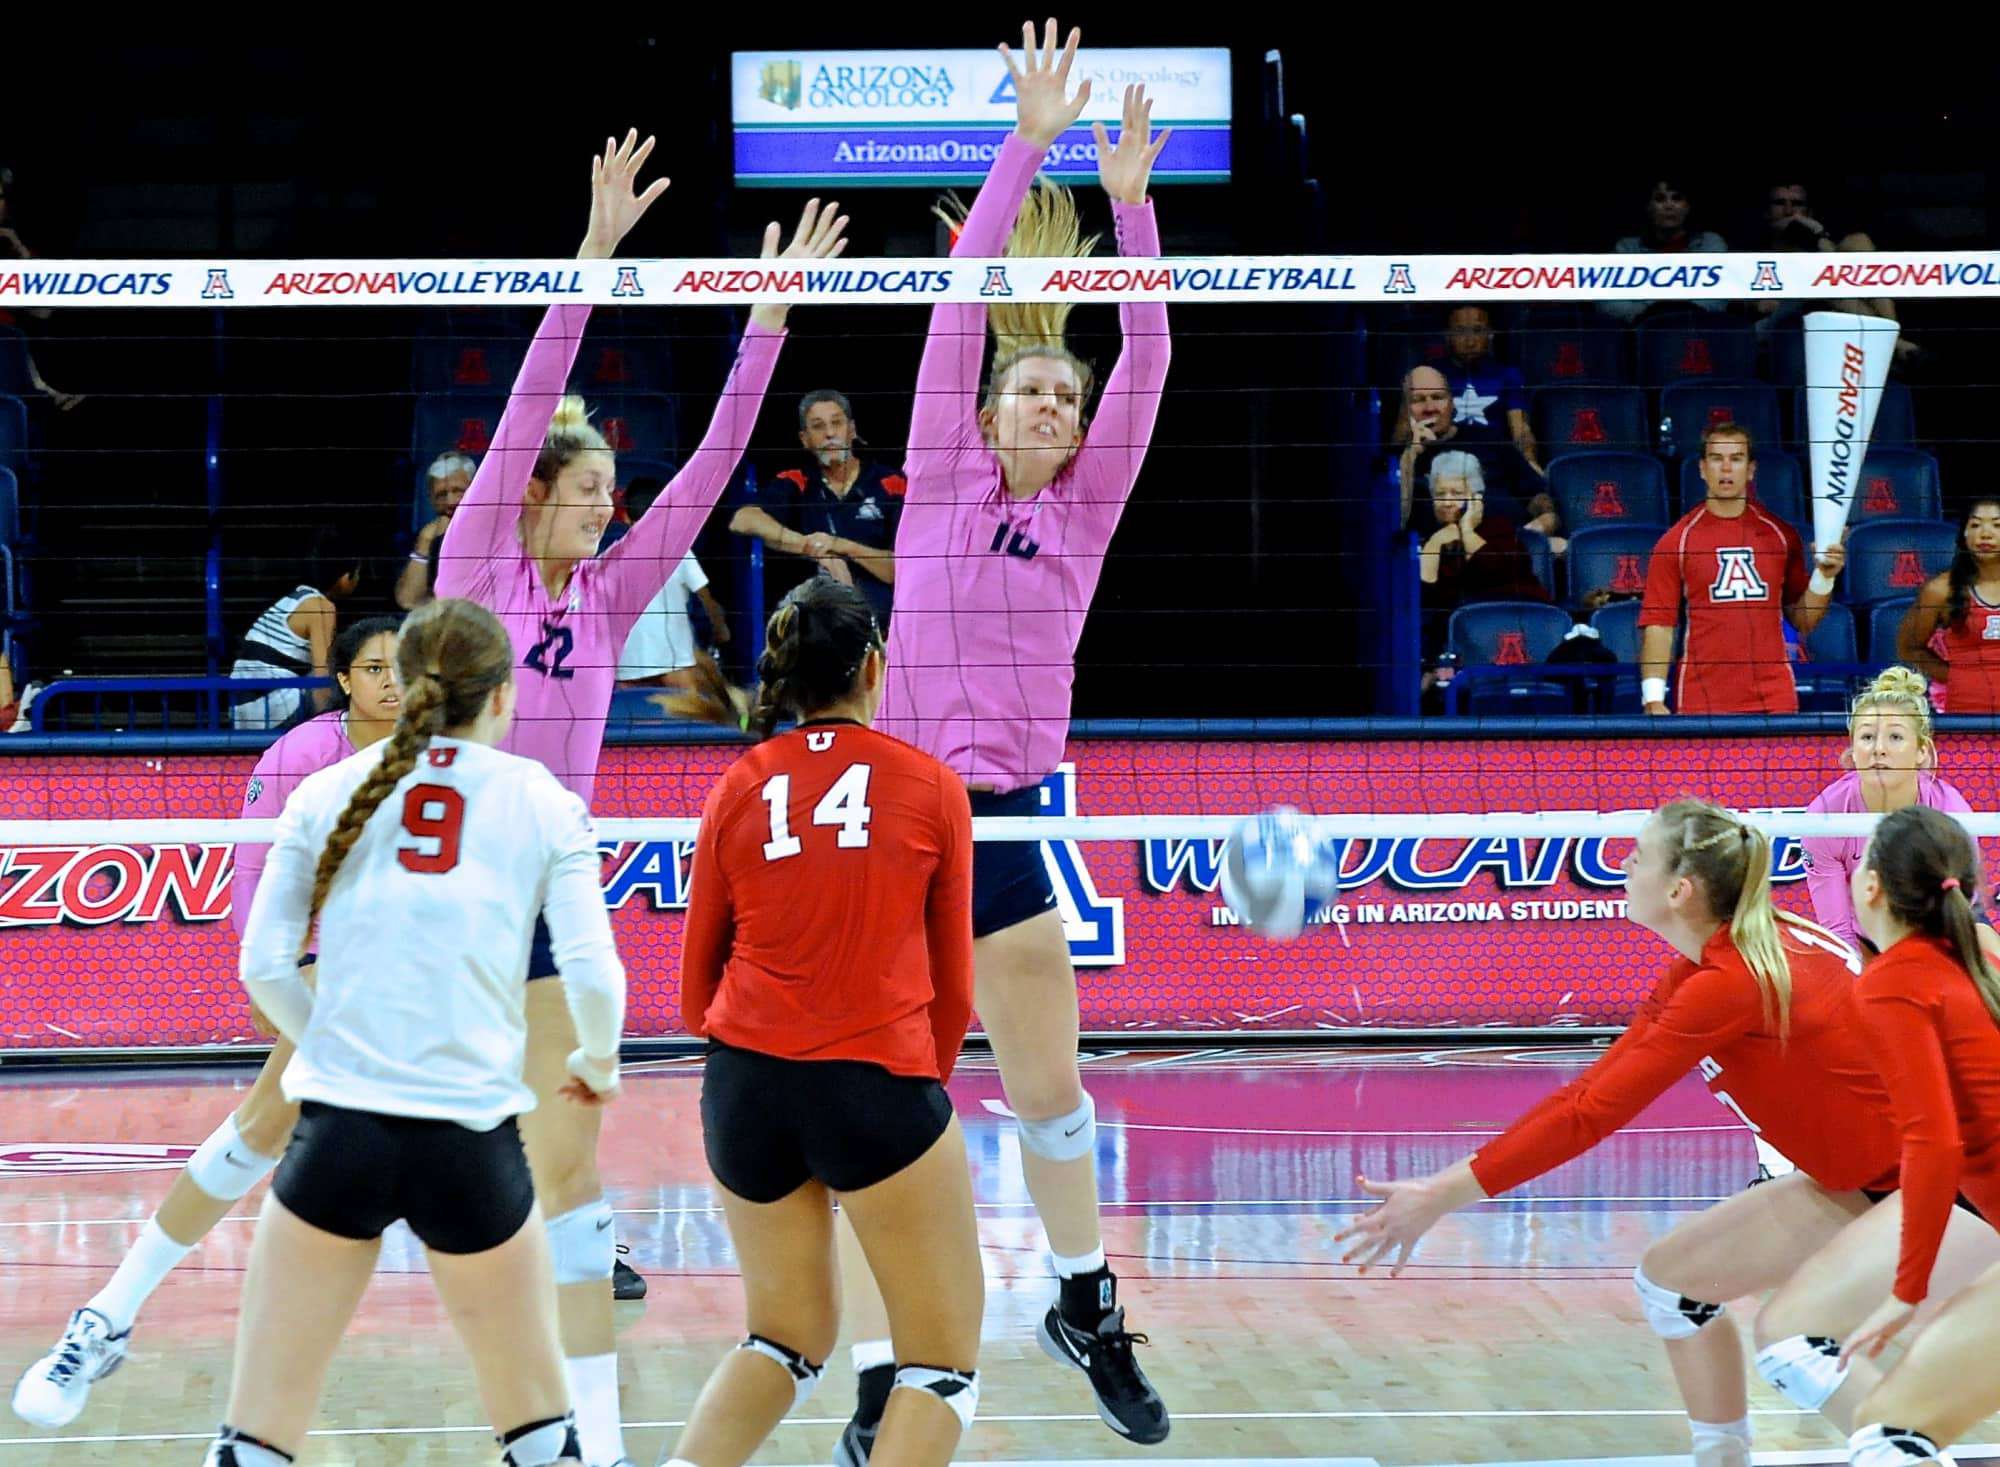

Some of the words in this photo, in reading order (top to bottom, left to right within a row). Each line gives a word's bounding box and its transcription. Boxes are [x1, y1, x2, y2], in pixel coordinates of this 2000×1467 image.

[809, 88, 950, 107] ONCOLOGY
[811, 64, 955, 92] ARIZONA
[1836, 342, 1864, 417] BEAR
[1826, 418, 1855, 507] DOWN
[1708, 546, 1770, 603] A
[523, 623, 575, 678] 22
[429, 747, 458, 769] U
[807, 731, 836, 752] U
[397, 783, 466, 875] 9
[761, 763, 872, 862] 14
[1357, 903, 1385, 923] IN
[1389, 902, 1505, 923] ARIZONA
